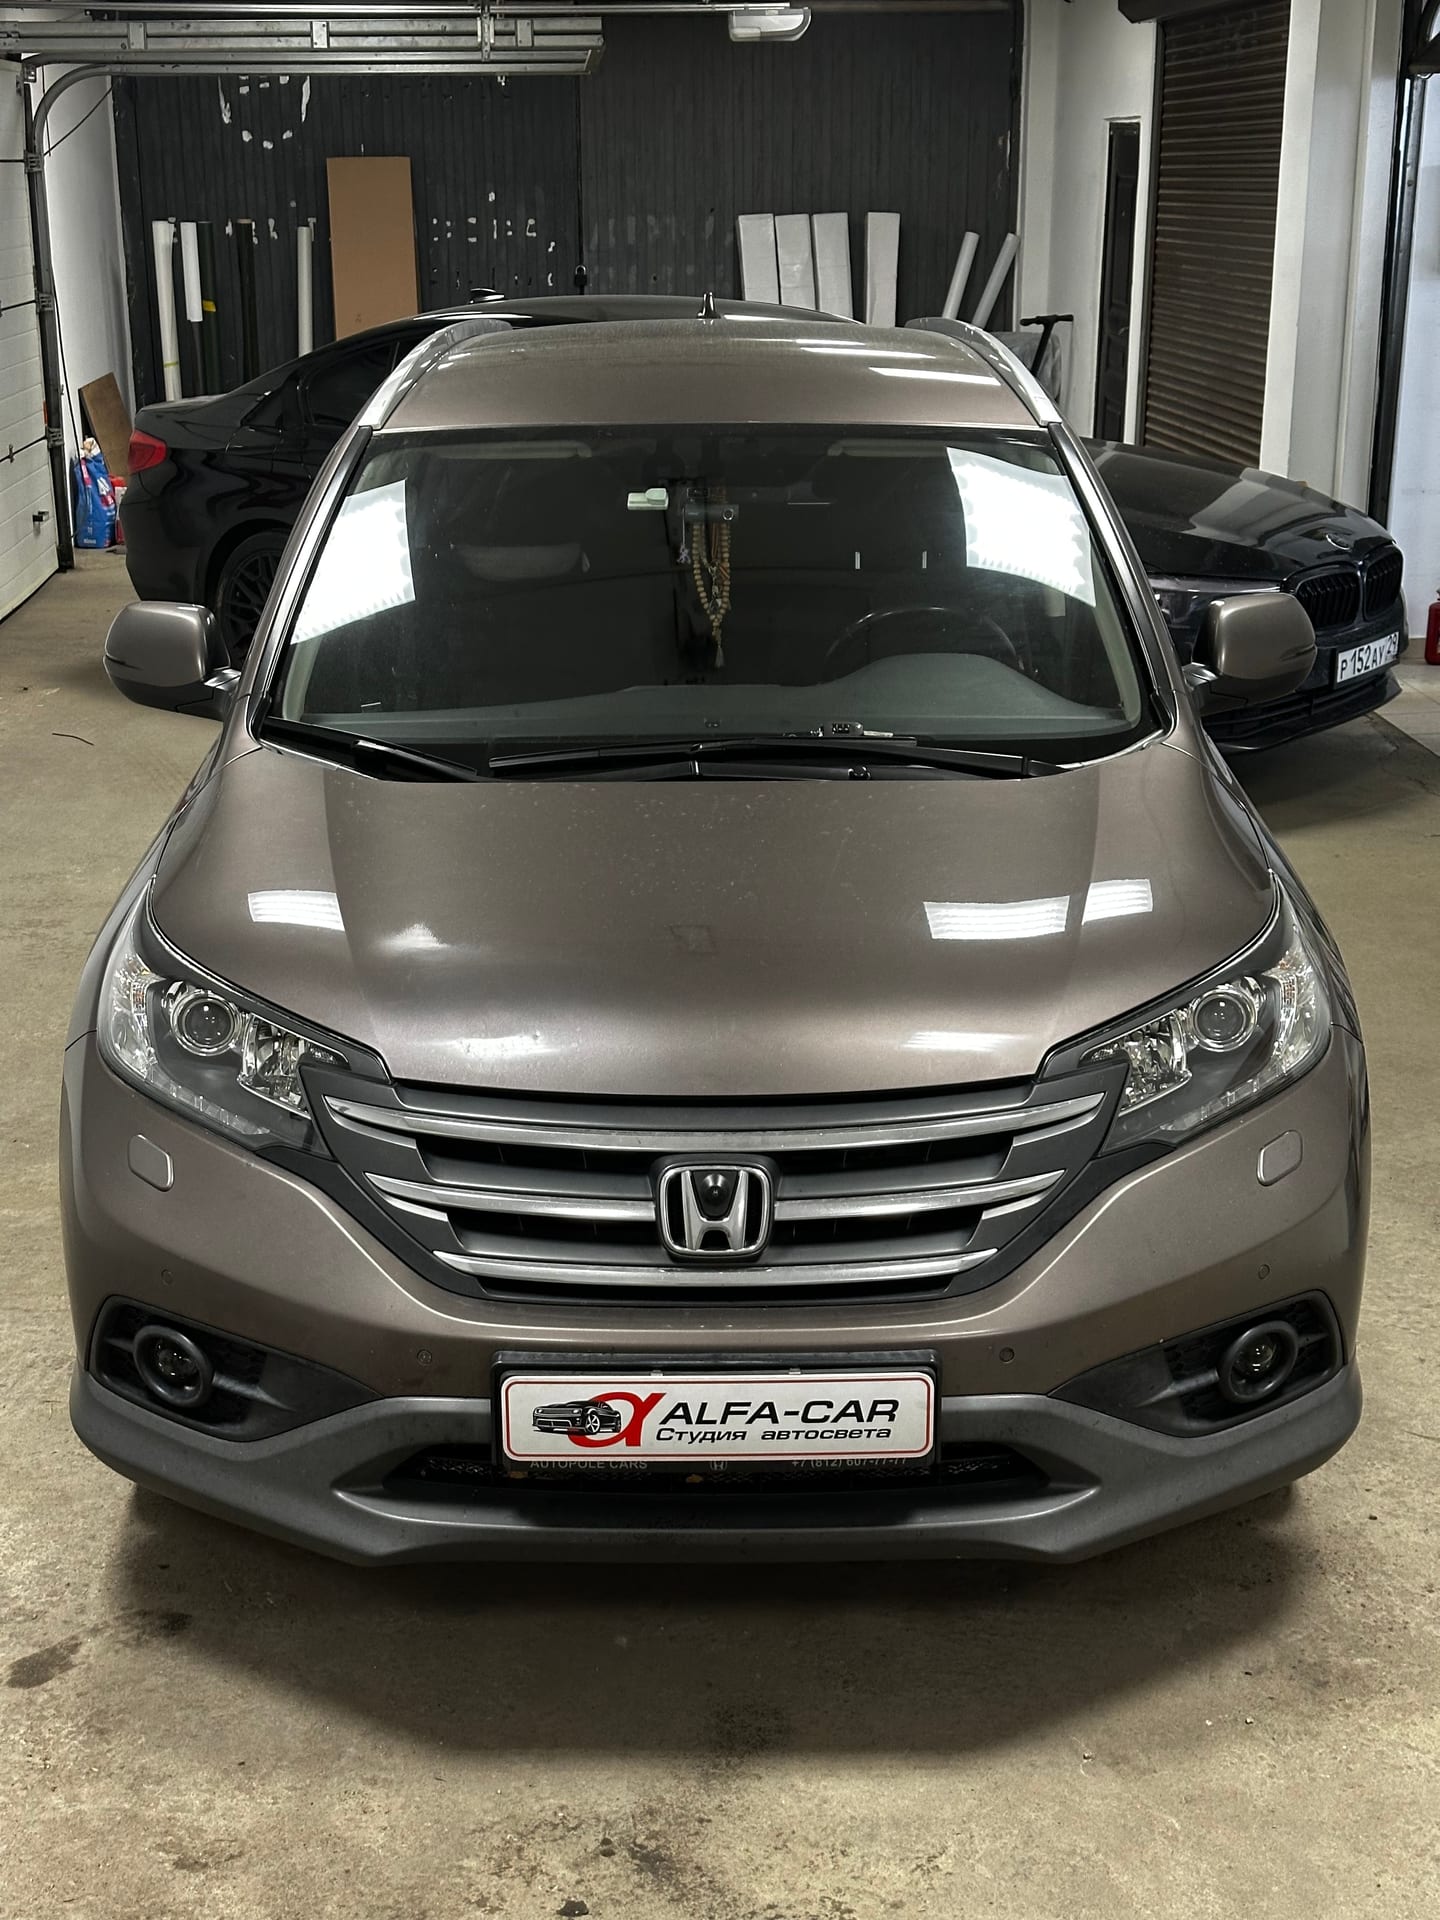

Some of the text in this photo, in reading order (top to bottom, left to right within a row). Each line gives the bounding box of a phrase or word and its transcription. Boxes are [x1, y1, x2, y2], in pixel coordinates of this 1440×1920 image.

[659, 1400, 900, 1425] ALFA-CAR
[656, 1428, 892, 1444] Студия автосвета
[530, 1460, 648, 1469] AUTOPOLE CARS
